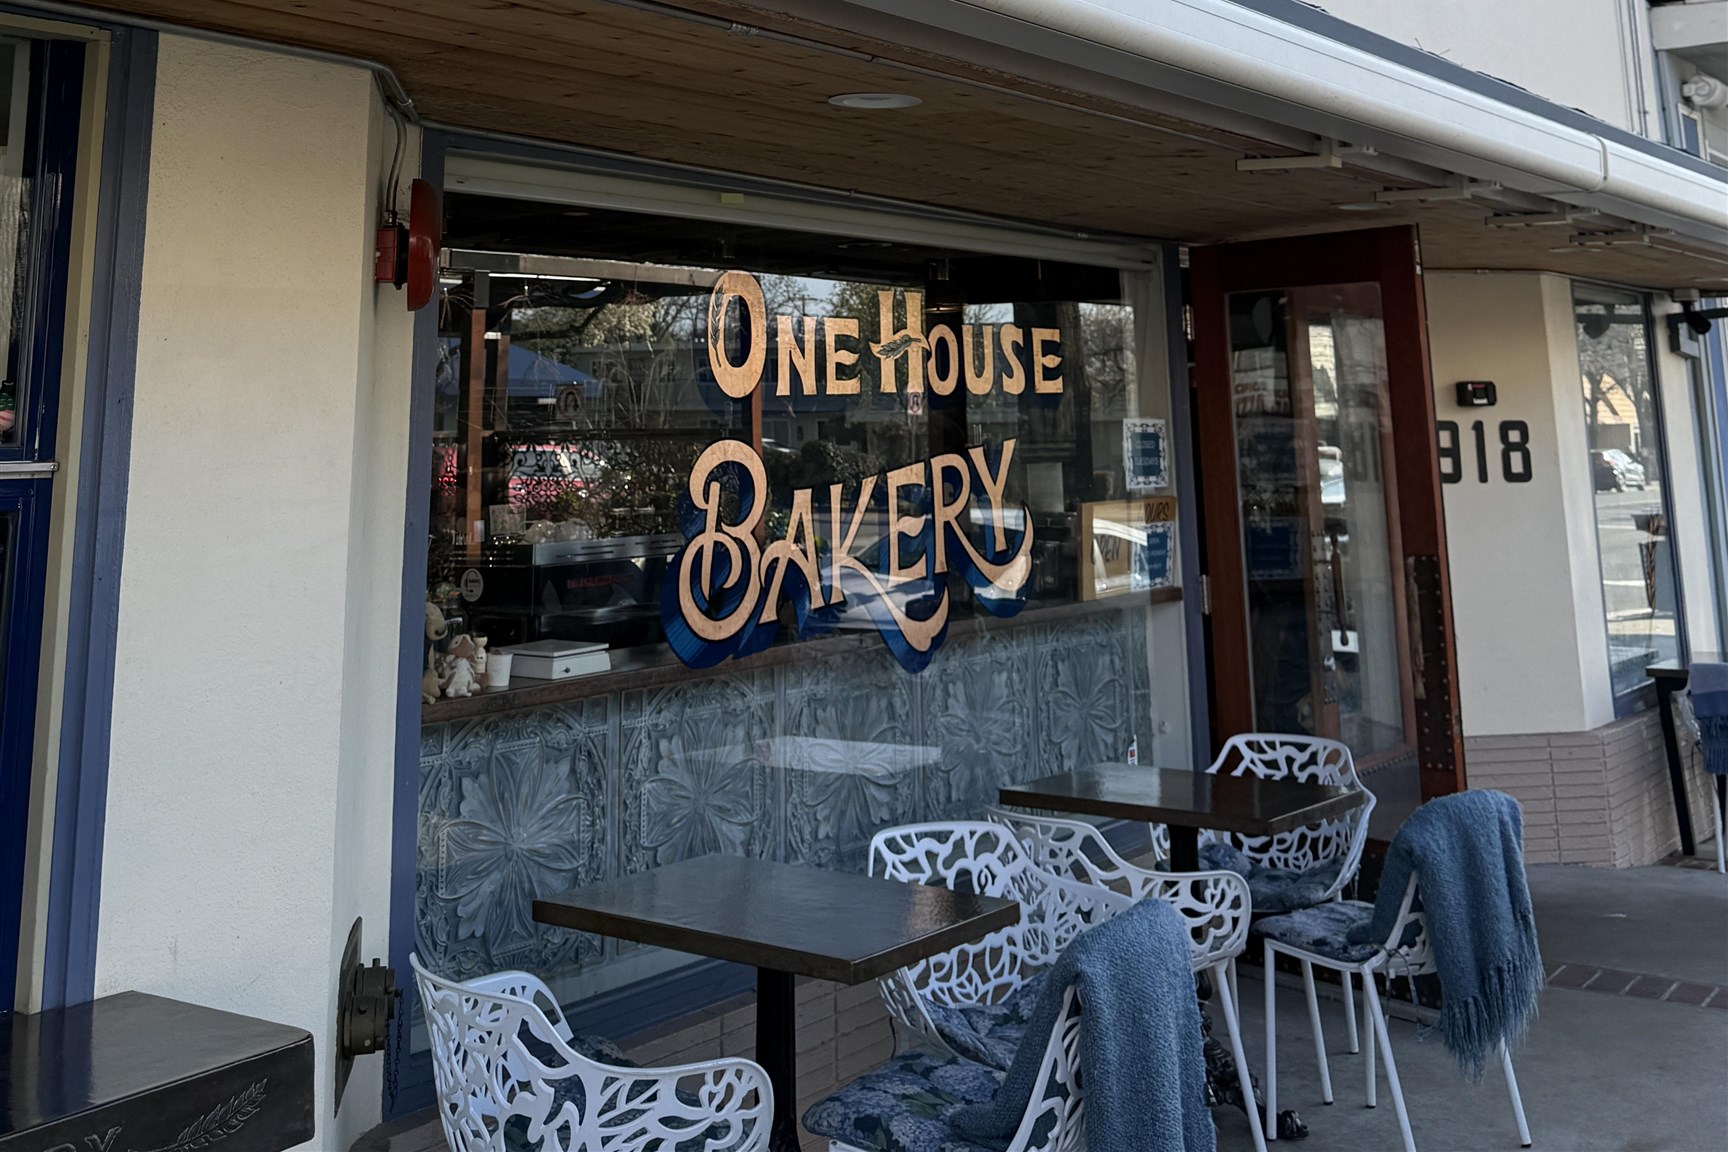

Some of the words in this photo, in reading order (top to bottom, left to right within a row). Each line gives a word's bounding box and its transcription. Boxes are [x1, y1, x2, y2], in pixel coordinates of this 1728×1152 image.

[708, 269, 861, 399] ONE
[869, 289, 1065, 397] HOUSE
[1436, 420, 1533, 484] 918
[678, 438, 1035, 653] BAKERY
